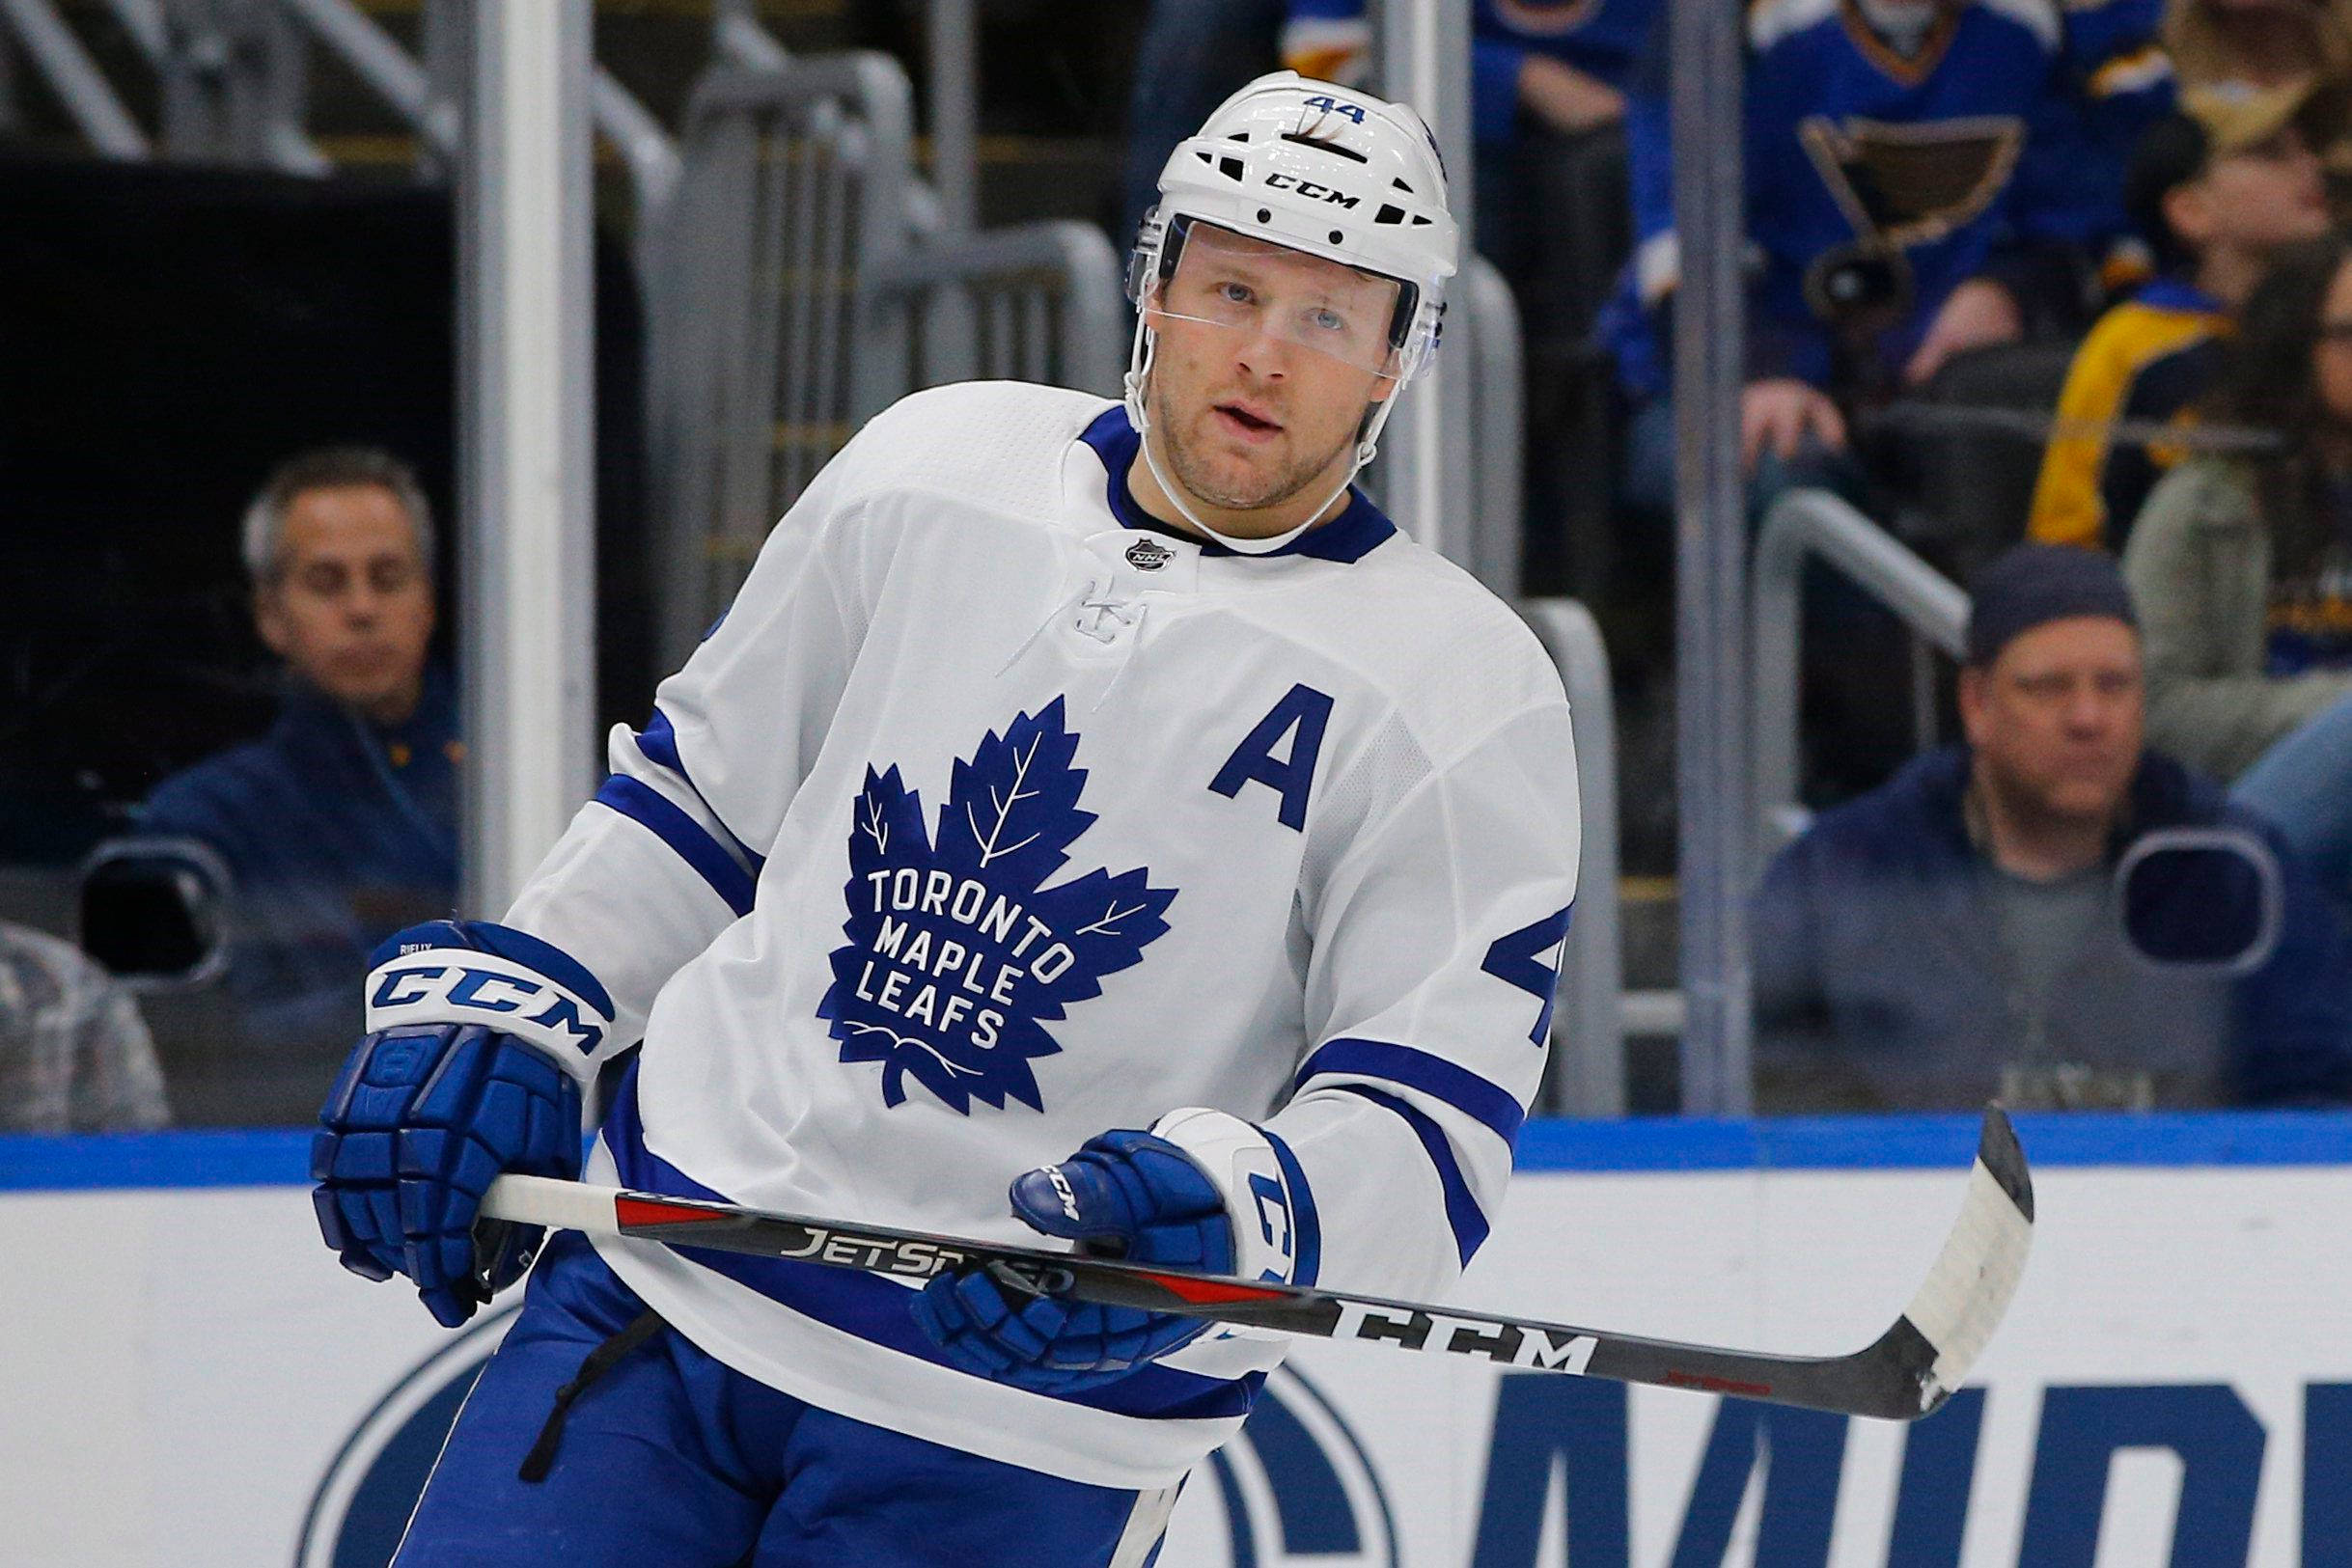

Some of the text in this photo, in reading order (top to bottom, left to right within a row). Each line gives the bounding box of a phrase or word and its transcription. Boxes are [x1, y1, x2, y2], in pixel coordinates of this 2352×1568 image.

[1302, 96, 1367, 125] 44
[1264, 173, 1361, 209] CCM
[1208, 683, 1335, 834] A
[868, 867, 1076, 985] TORONTO
[872, 915, 1024, 1006] MAPLE
[372, 967, 604, 1057] CCM
[855, 960, 1005, 1050] LEAFS
[1332, 1299, 1600, 1375] CCM
